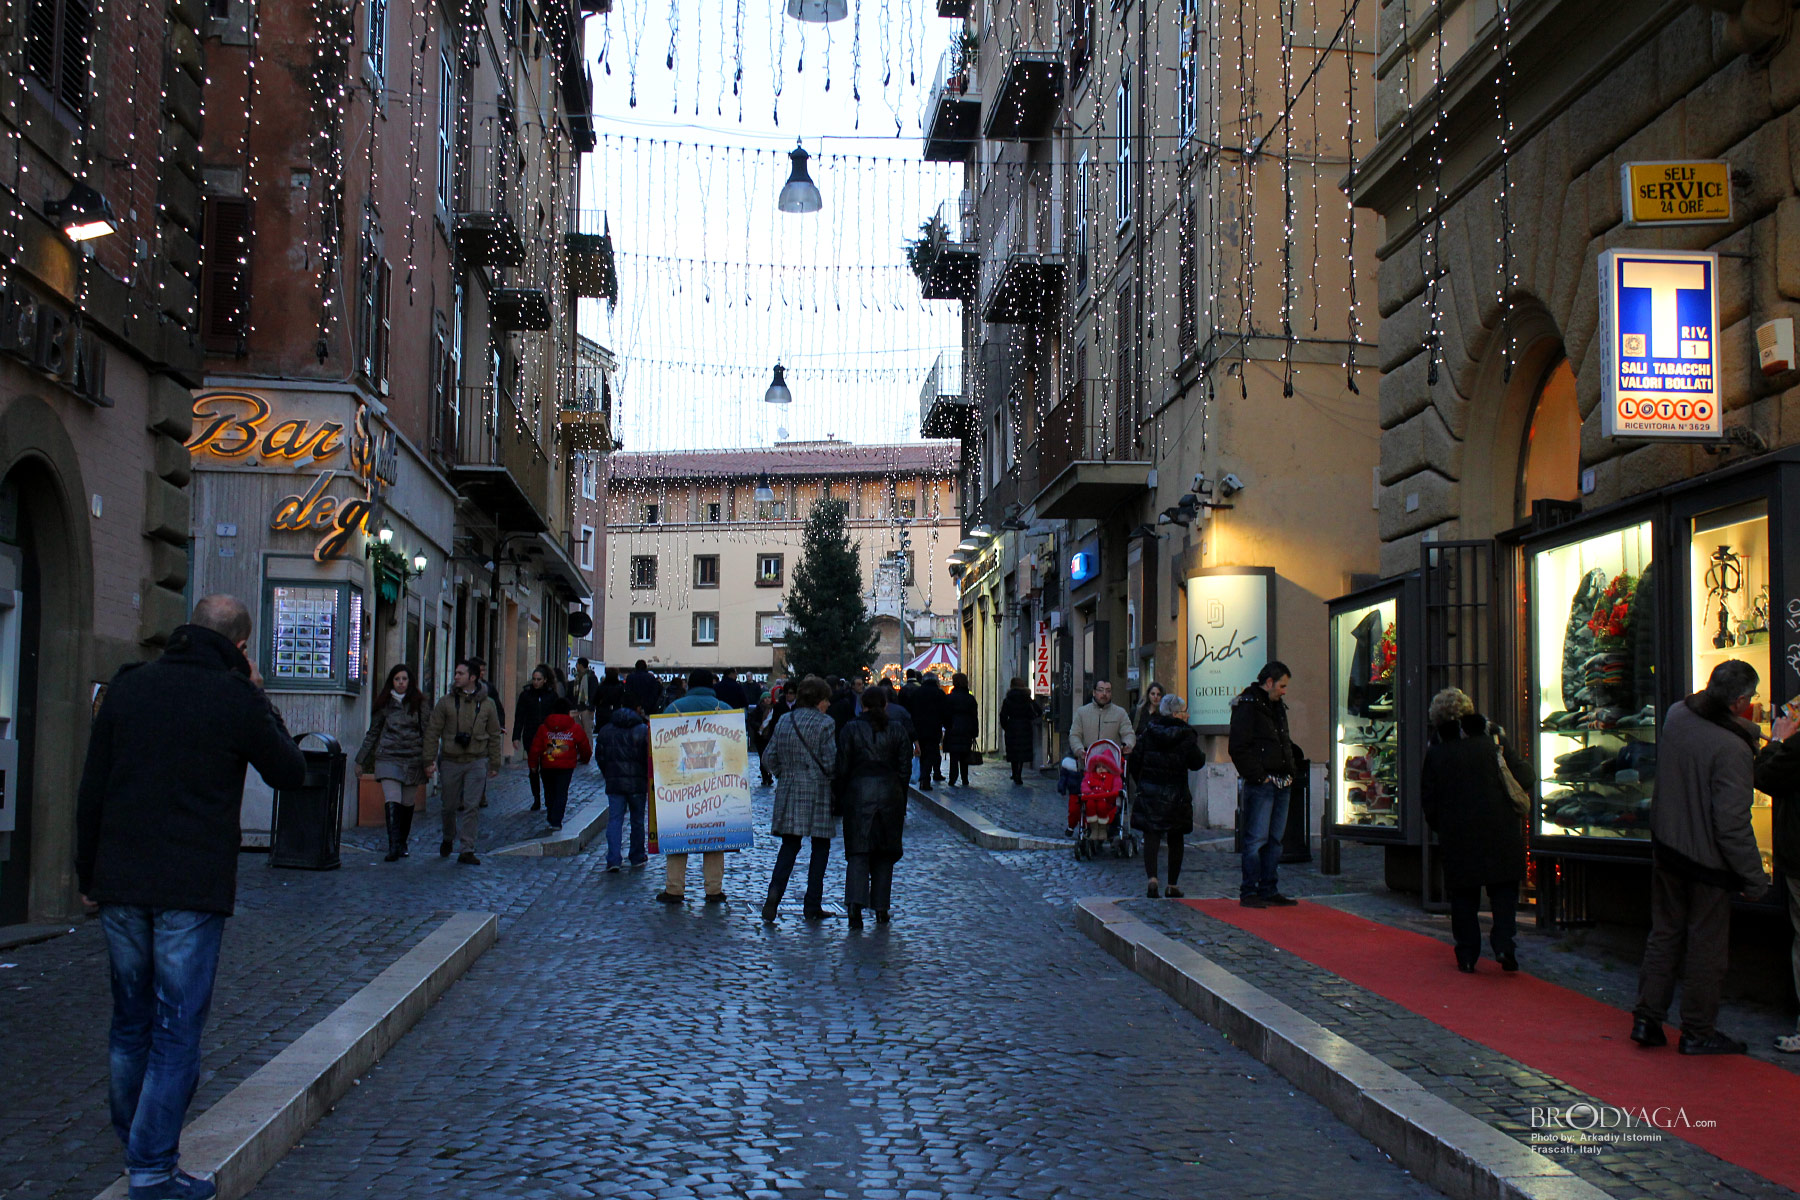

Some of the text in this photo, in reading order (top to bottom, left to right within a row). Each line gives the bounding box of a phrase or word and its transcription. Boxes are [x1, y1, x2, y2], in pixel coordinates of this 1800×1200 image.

[1664, 167, 1696, 180] SELF
[1640, 181, 1723, 199] SERVICE
[1661, 199, 1704, 214] 24 ORE
[1623, 262, 1705, 358] T
[1681, 326, 1708, 339] RIV.
[1691, 344, 1697, 355] 1
[1621, 362, 1711, 376] SALI TABACCHI
[1621, 376, 1712, 390] VALORI BOLLATI
[184, 391, 345, 460] Bar
[1625, 422, 1675, 430] RICEVITORIA
[1037, 621, 1049, 687] PIZZA
[655, 717, 745, 749] Tesori Nascosti
[657, 774, 748, 803] COMPRA-VENDITA
[686, 795, 722, 819] USATO
[686, 821, 726, 830] FRASCATI
